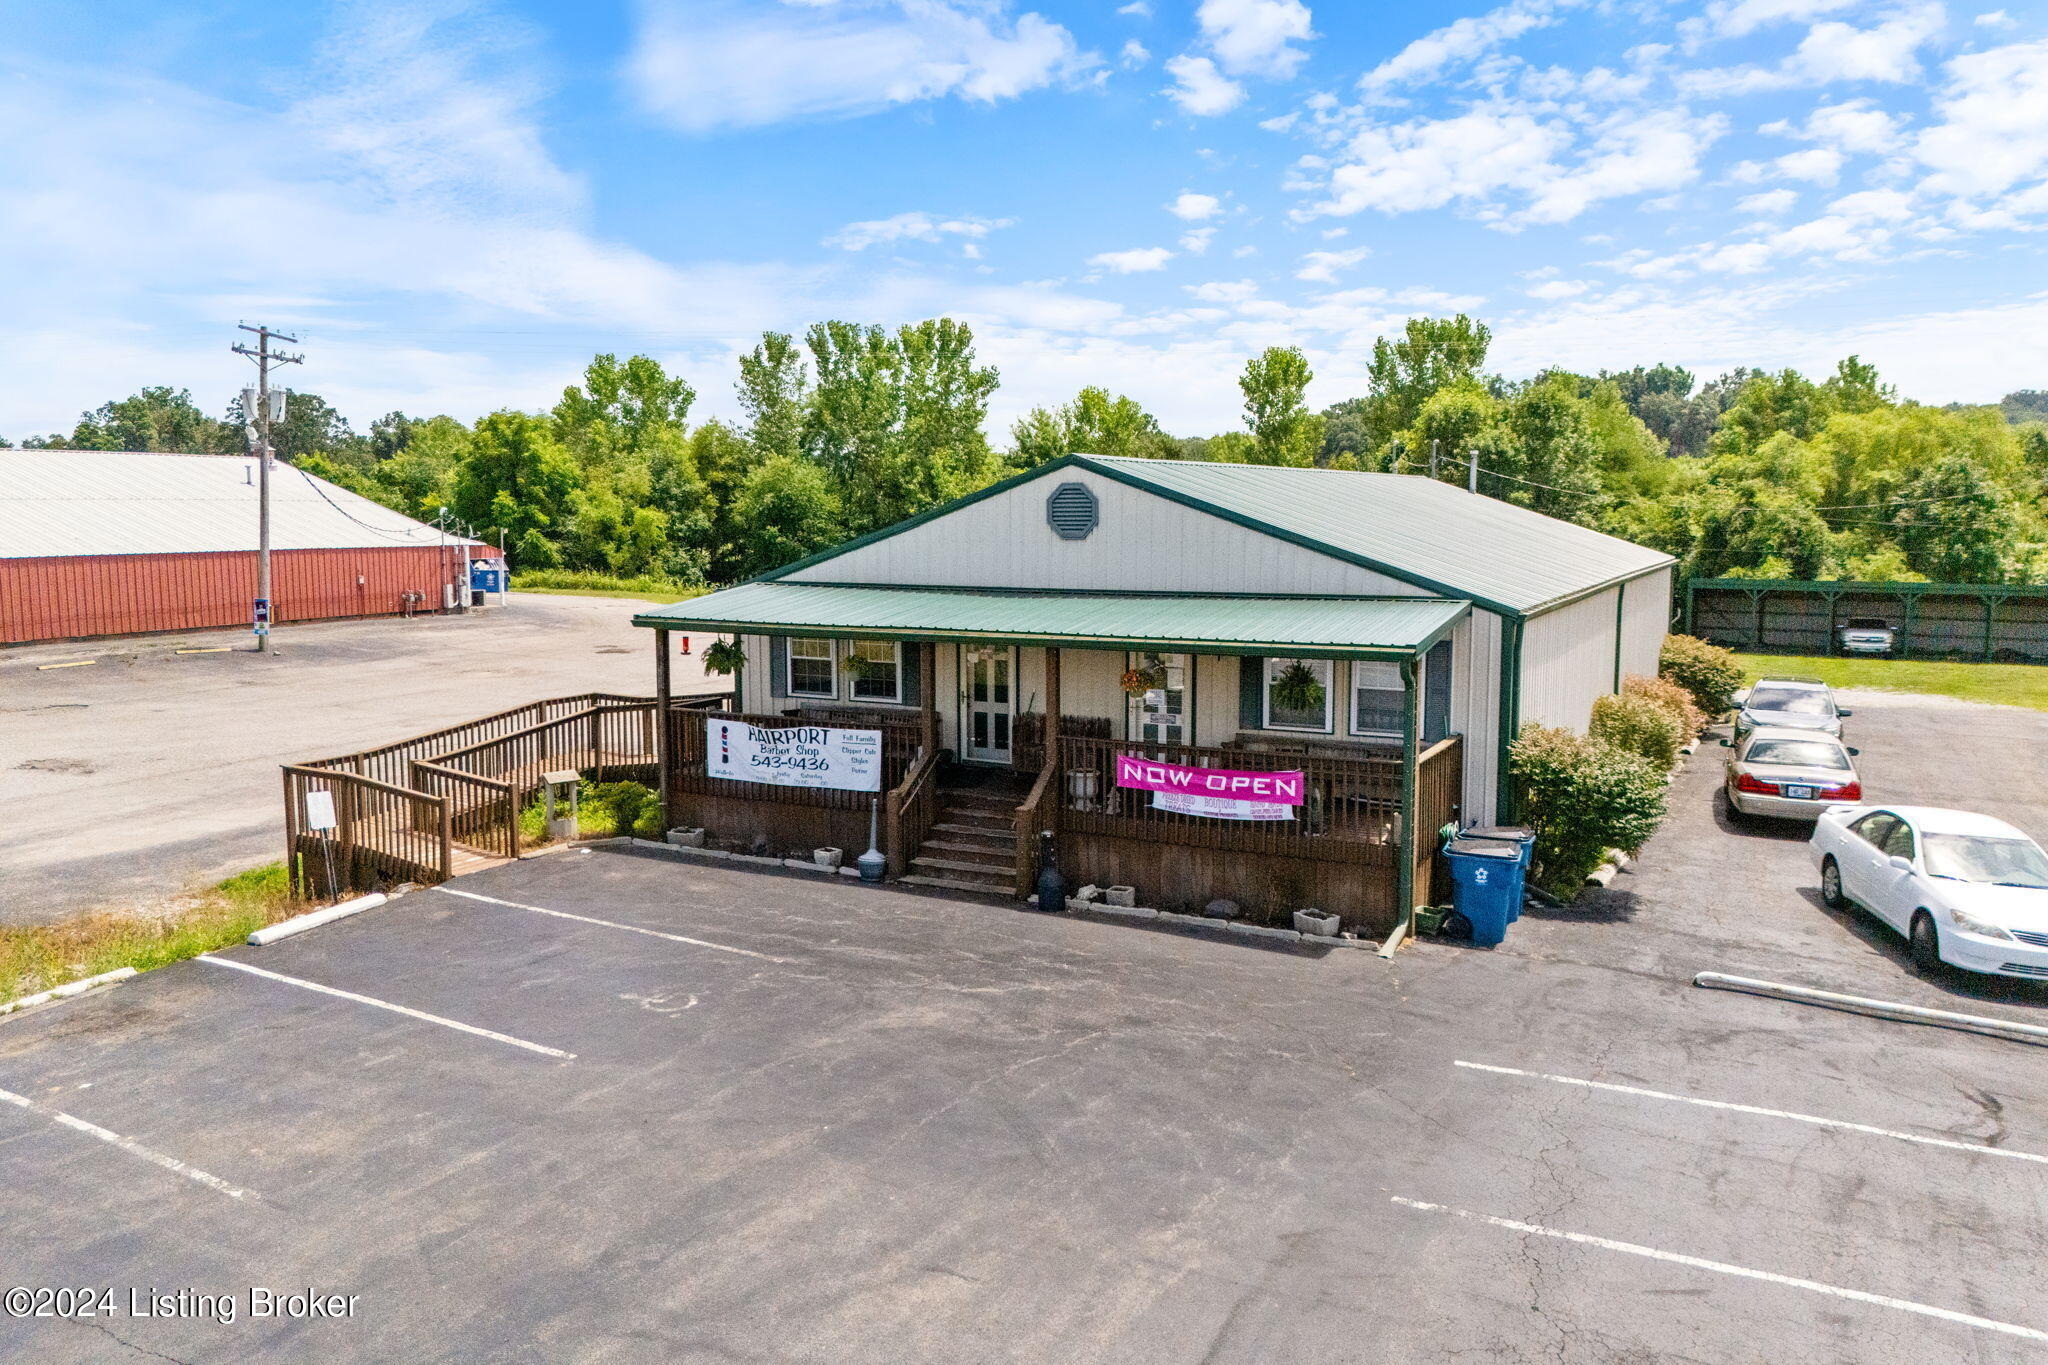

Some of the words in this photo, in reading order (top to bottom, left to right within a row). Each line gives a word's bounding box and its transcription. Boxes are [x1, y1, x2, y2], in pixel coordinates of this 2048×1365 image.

[748, 726, 831, 746] HAIRPORT
[760, 743, 790, 755] Barber
[796, 744, 820, 757] Shop
[750, 754, 830, 771] 543-9436
[1124, 763, 1193, 787] NOW
[1206, 775, 1296, 797] OPEN
[1204, 797, 1238, 810] BOUTIQUE
